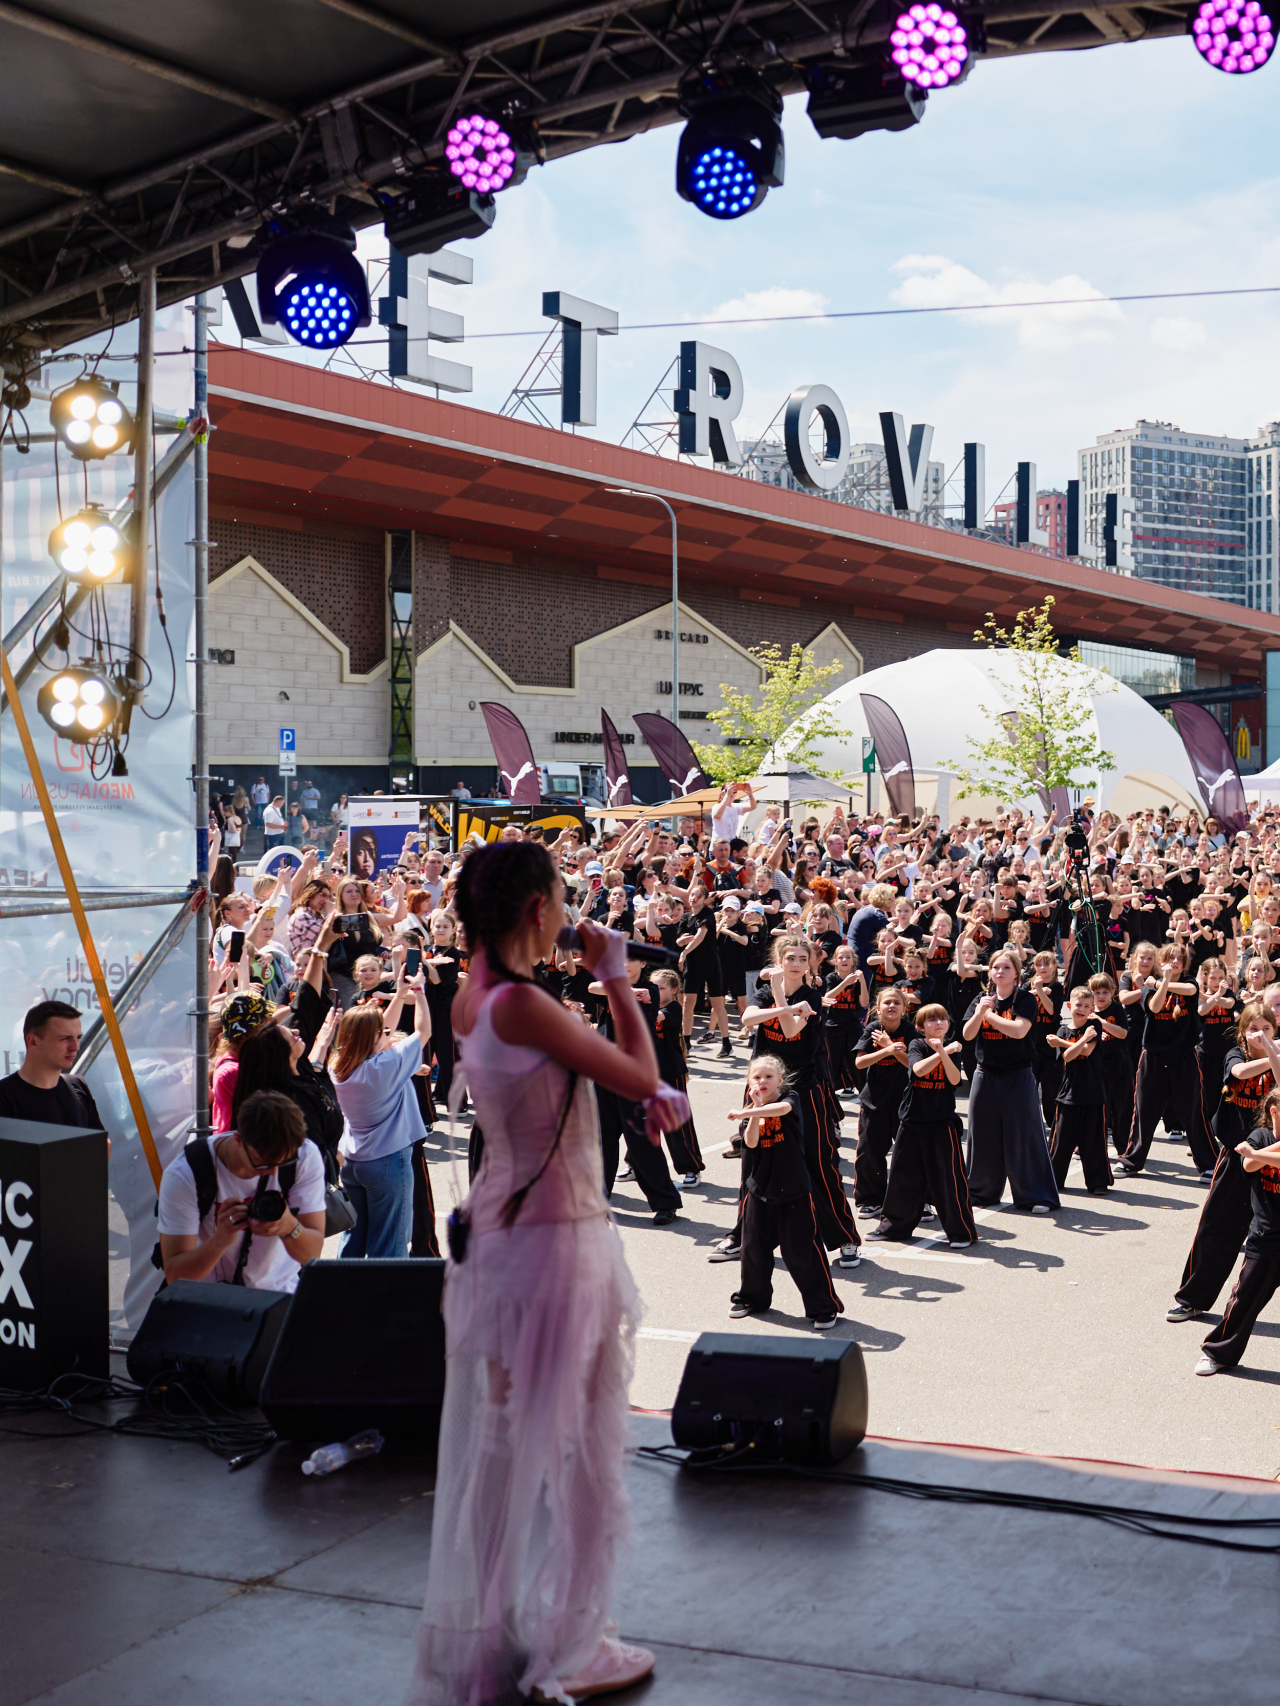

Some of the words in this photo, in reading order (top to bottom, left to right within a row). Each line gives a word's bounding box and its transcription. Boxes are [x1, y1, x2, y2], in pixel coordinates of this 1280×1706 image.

[656, 629, 709, 644] BRCARD
[283, 731, 293, 749] P
[554, 731, 590, 744] UNDER
[591, 733, 635, 745] ARUR
[429, 804, 453, 835] WILD
[0, 1179, 34, 1229] C
[0, 1318, 36, 1349] ON
